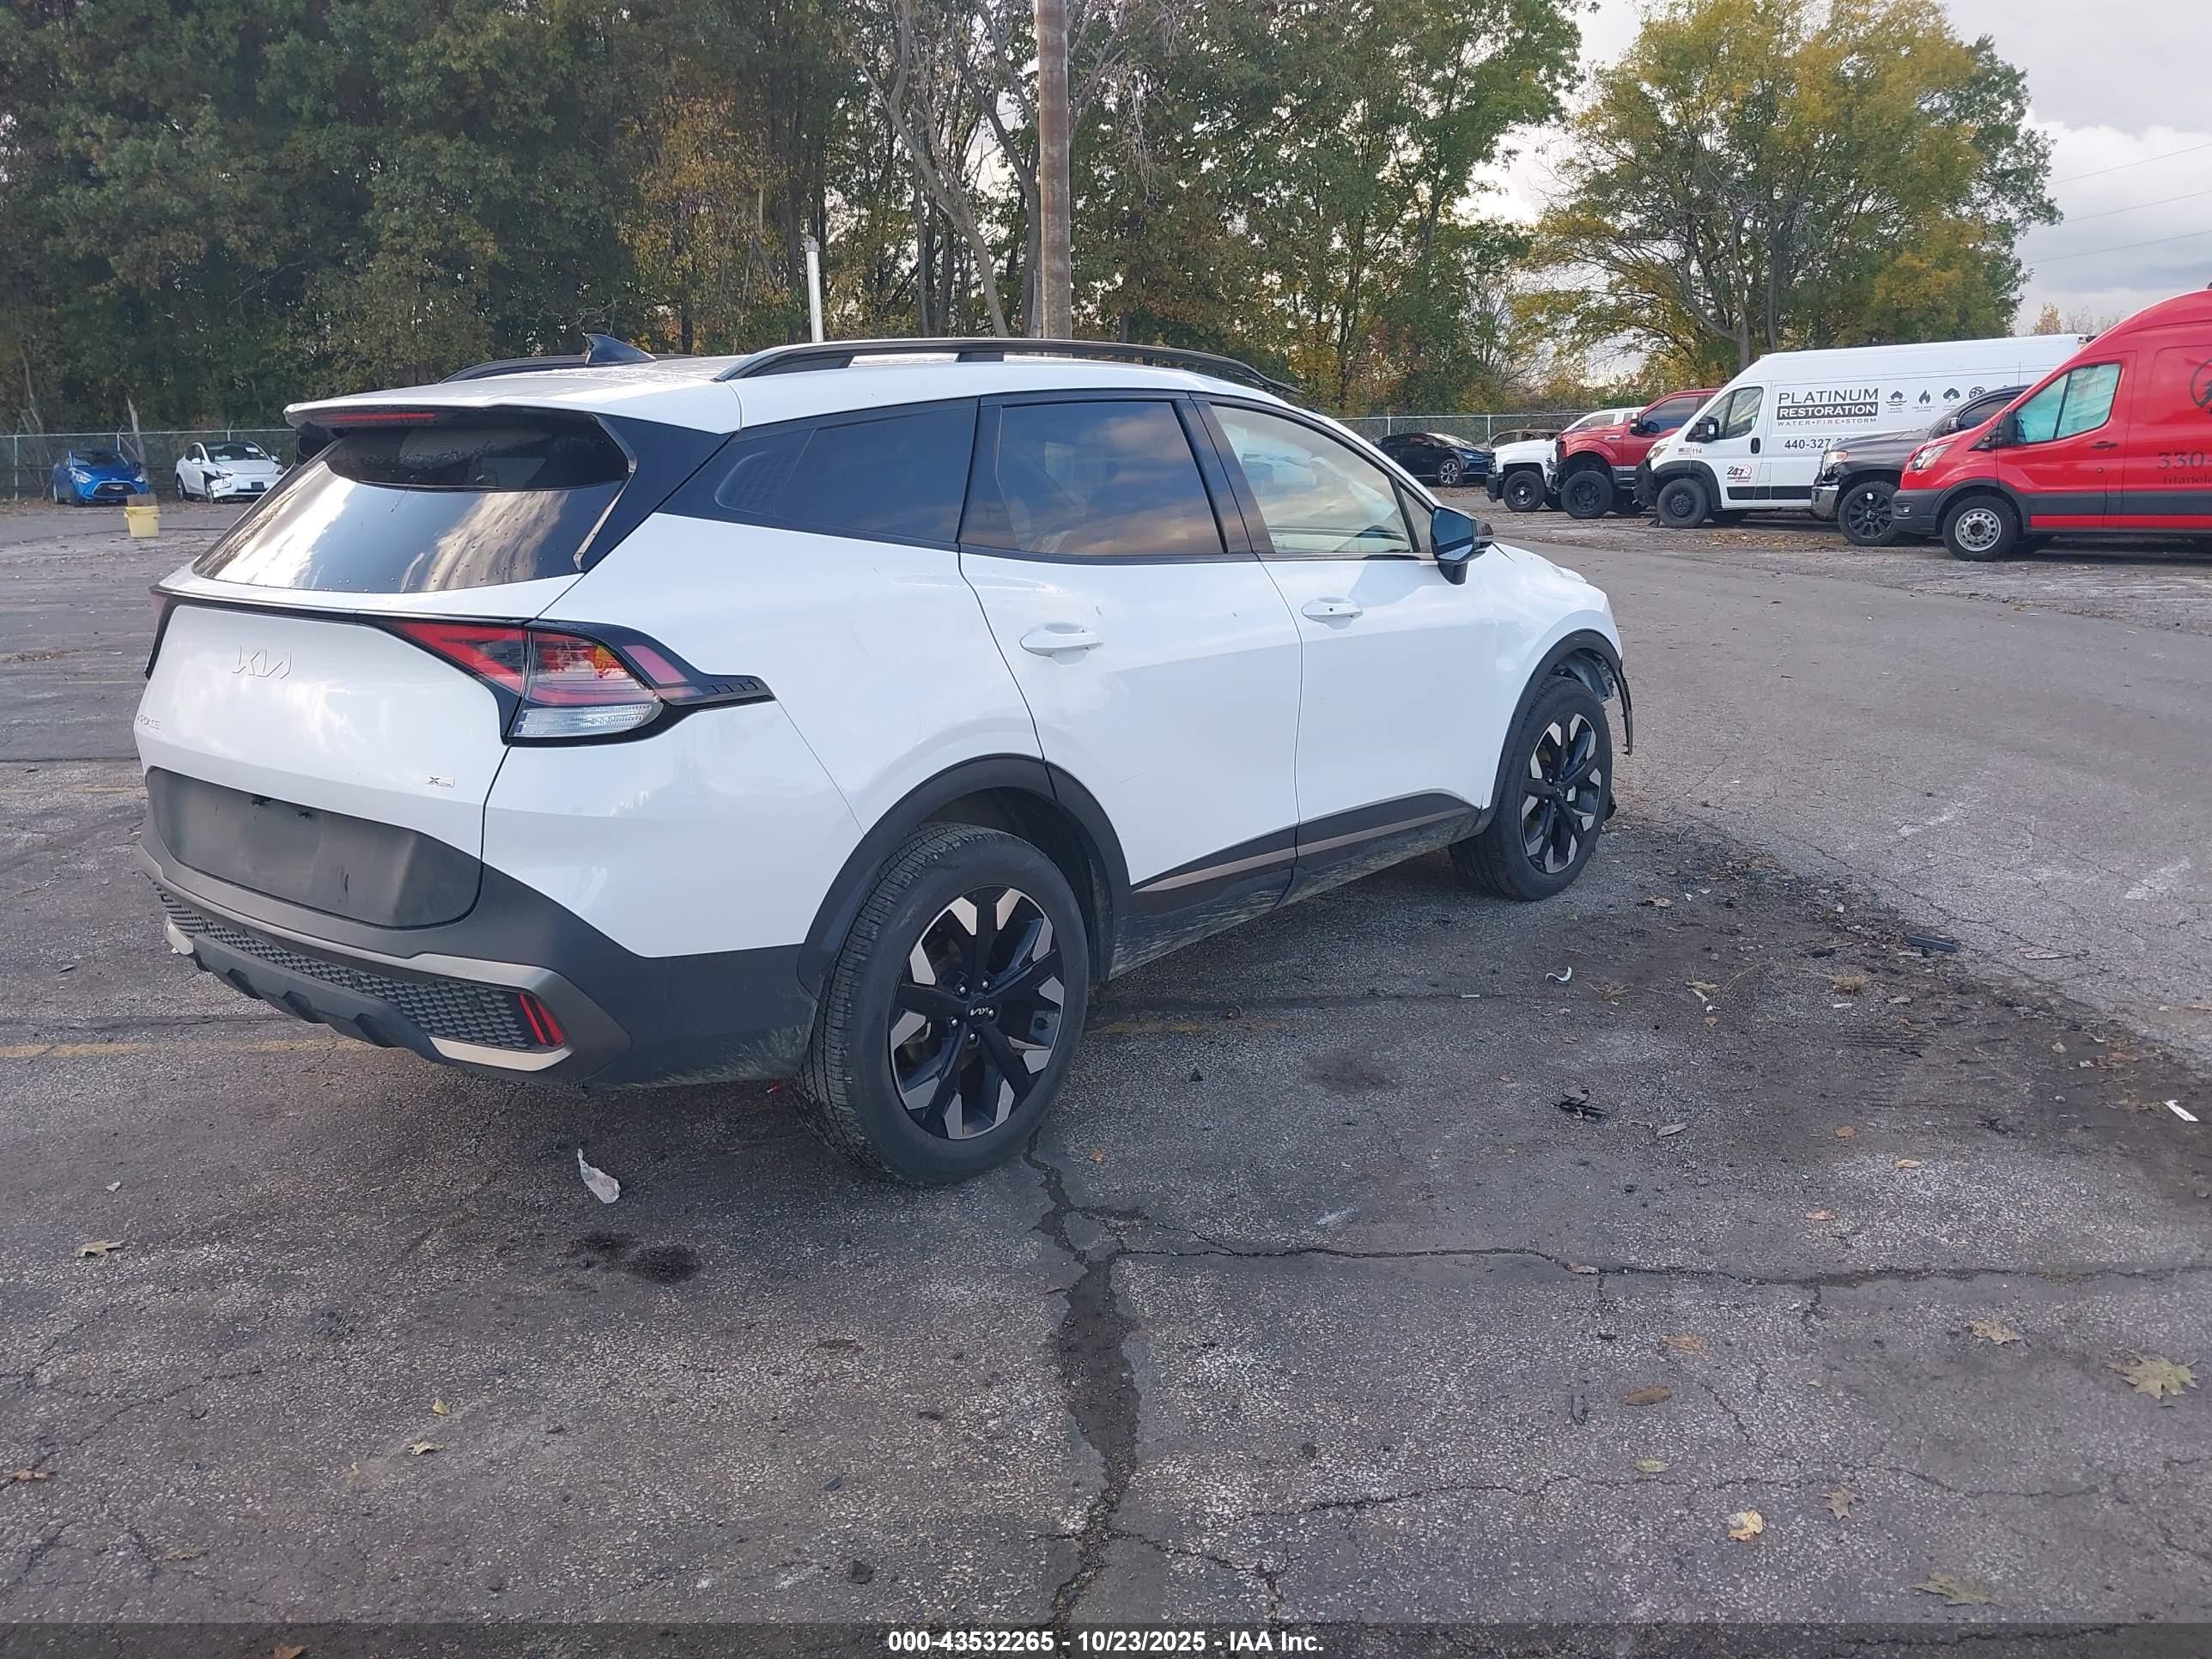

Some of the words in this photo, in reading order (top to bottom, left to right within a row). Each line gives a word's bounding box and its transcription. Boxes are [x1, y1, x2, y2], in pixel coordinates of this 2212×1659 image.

[1778, 388, 1879, 404] PLATINUM
[1779, 404, 1876, 418] RESTORATION
[1784, 438, 1849, 449] 440-327
[232, 645, 293, 679] KIA
